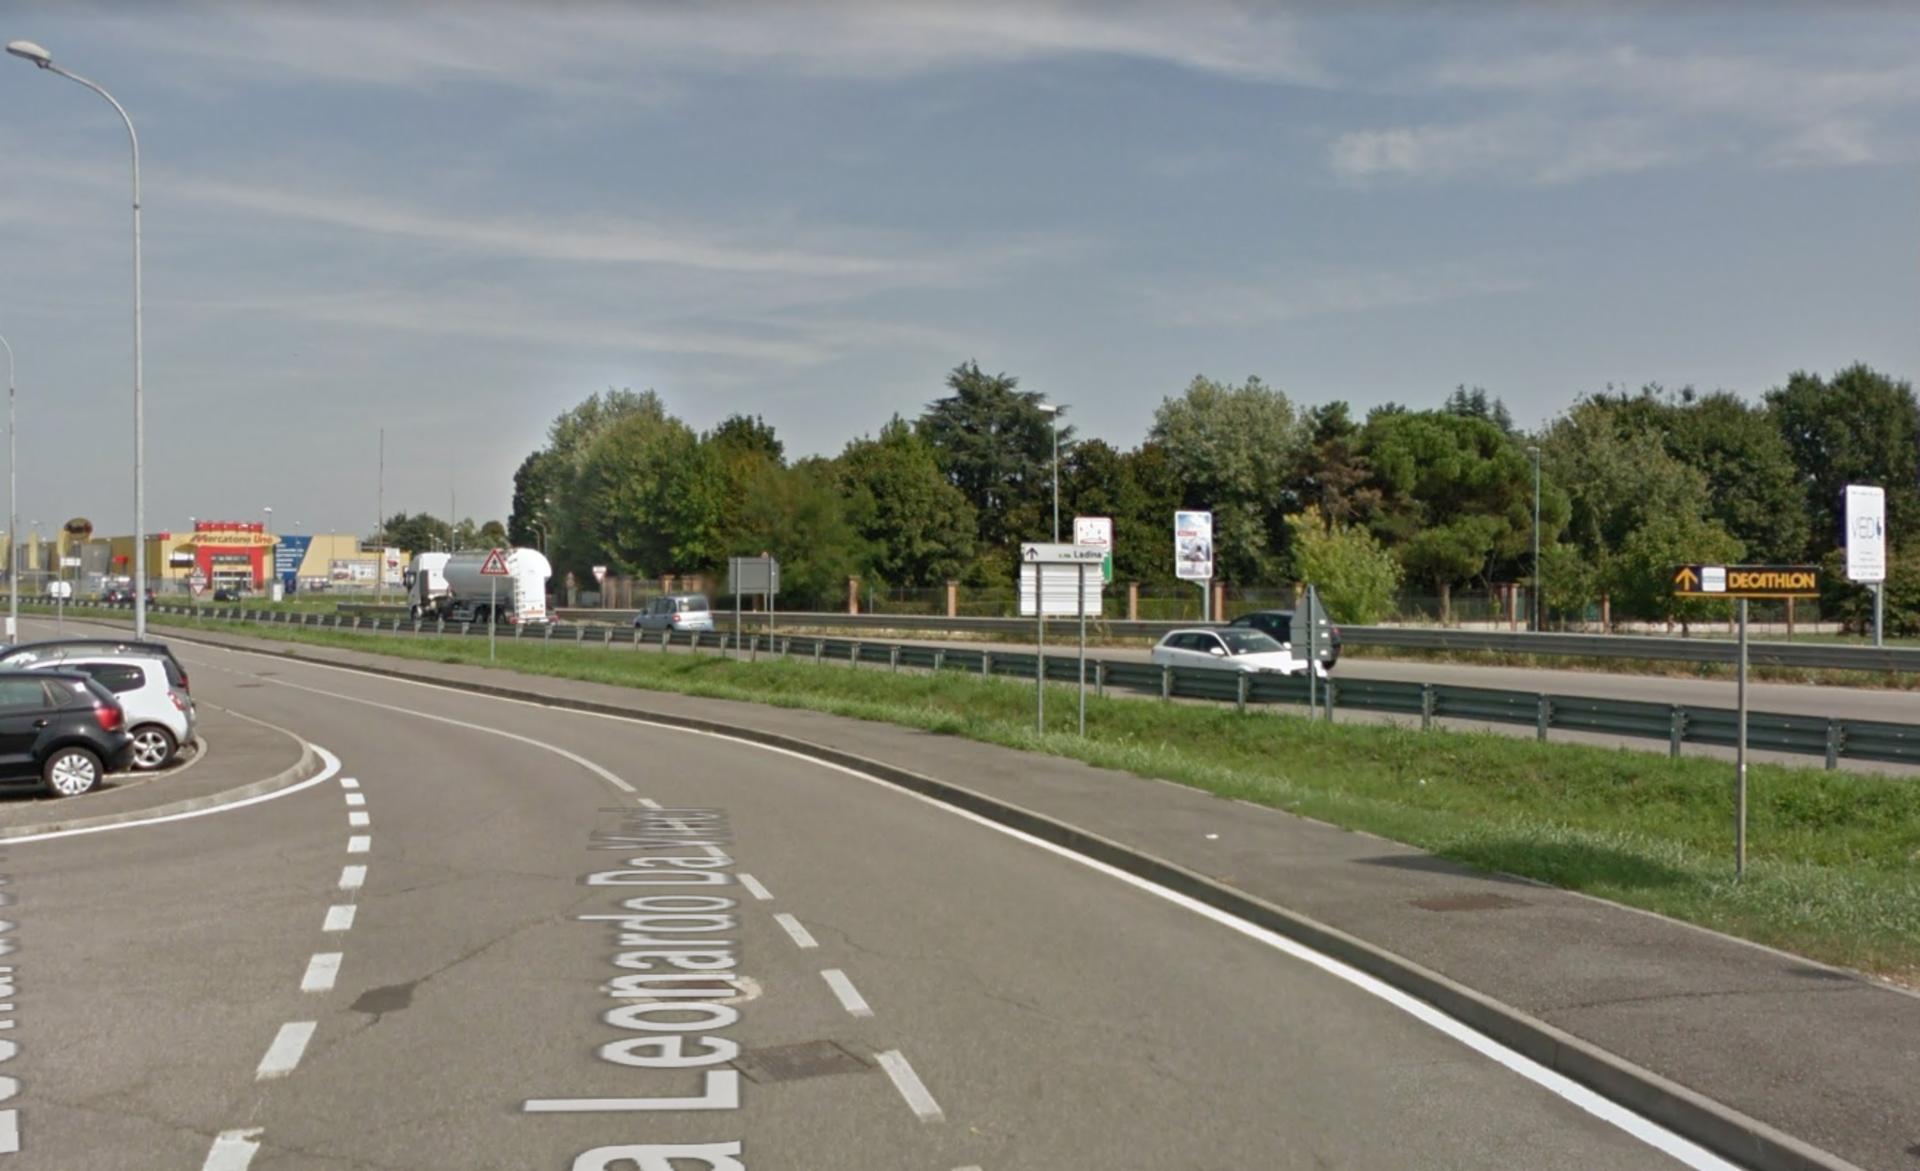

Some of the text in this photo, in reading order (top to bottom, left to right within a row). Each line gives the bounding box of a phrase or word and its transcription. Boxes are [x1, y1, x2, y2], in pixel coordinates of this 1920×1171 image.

[191, 534, 273, 545] Mercatone Uno
[1073, 550, 1103, 560] Ladina
[1728, 572, 1816, 589] DECATHLON
